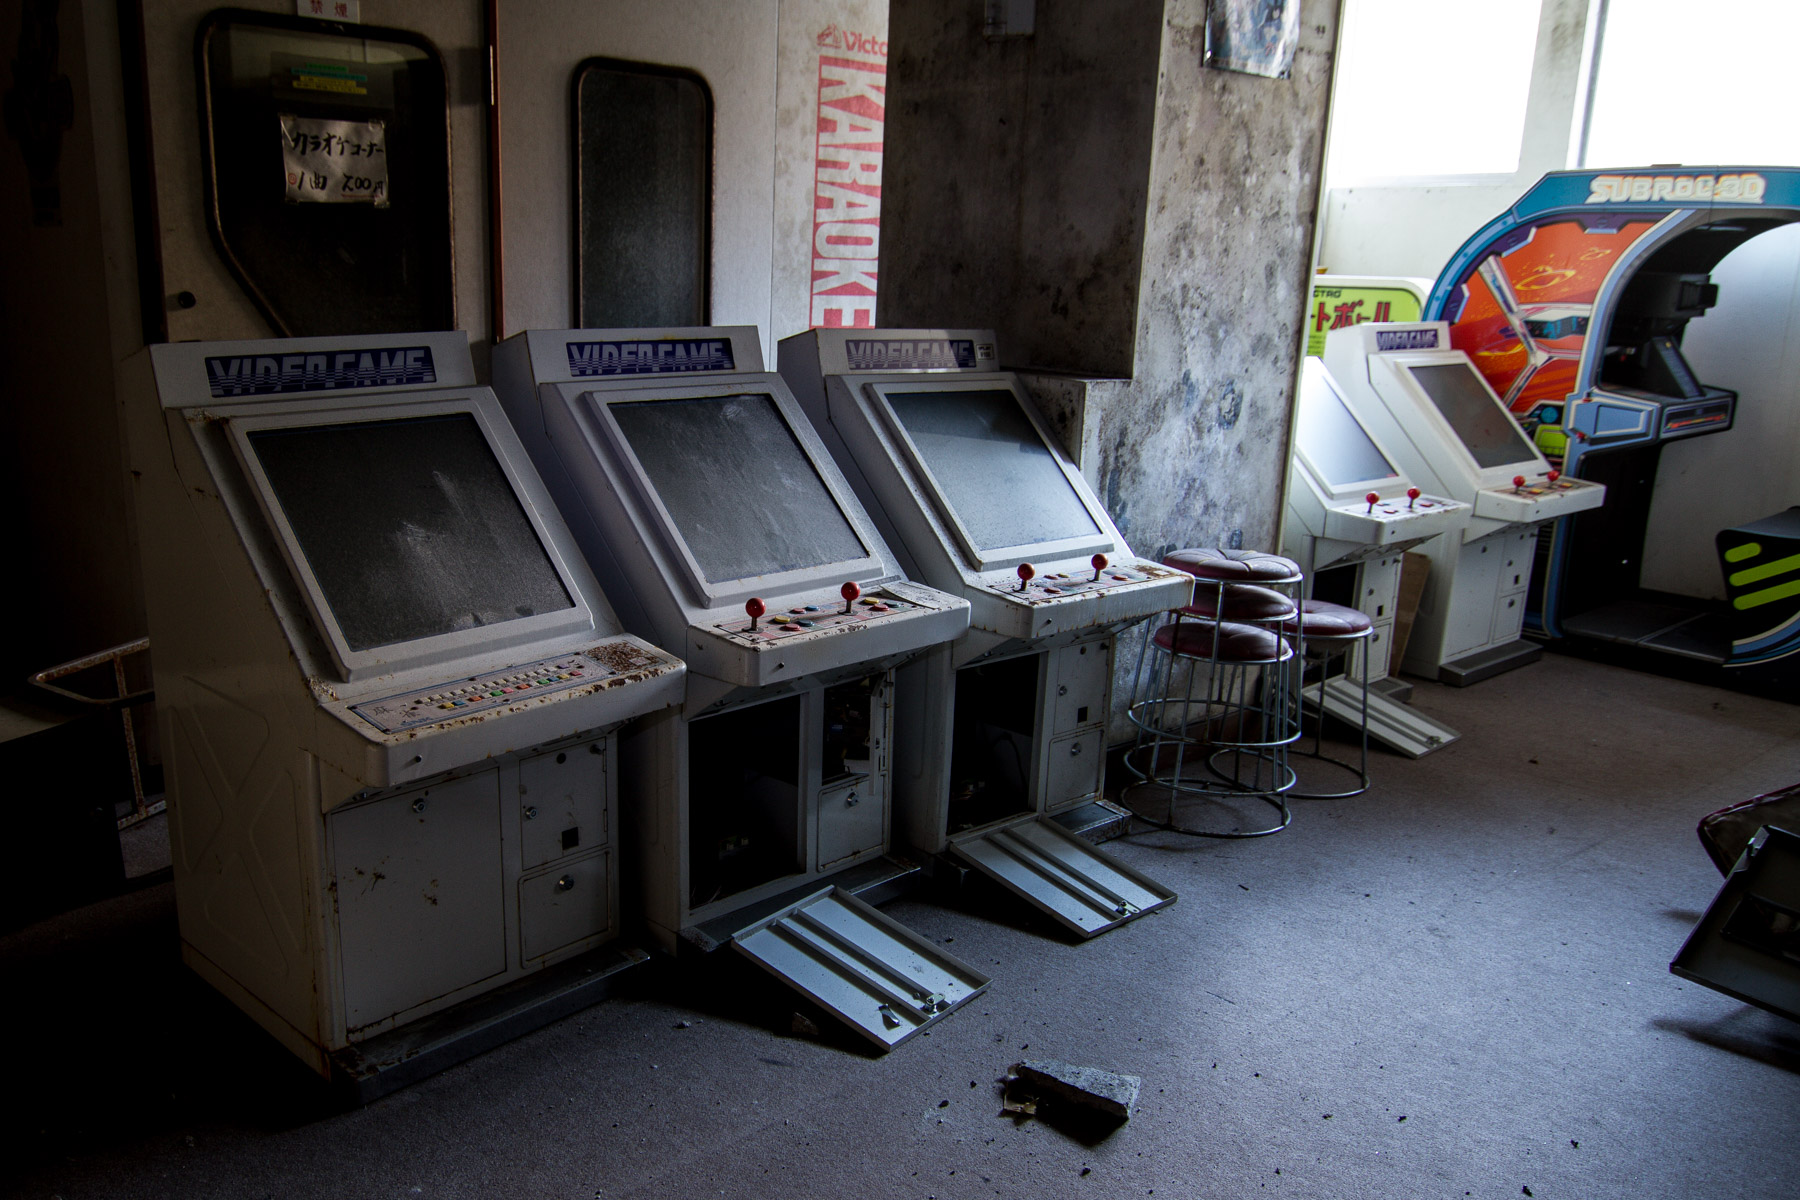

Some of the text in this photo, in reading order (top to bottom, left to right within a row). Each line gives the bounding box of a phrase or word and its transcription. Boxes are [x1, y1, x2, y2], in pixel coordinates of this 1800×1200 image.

[291, 132, 384, 157] カラオケコーナー
[811, 64, 888, 327] KARAOKE
[1311, 299, 1394, 332] トボール
[848, 342, 917, 369] VIDEO
[915, 341, 976, 369] GAME
[1377, 330, 1439, 351] VIDEO GAME
[208, 349, 437, 396] VIDEO GAME
[569, 341, 735, 376] VIDEO GAME
